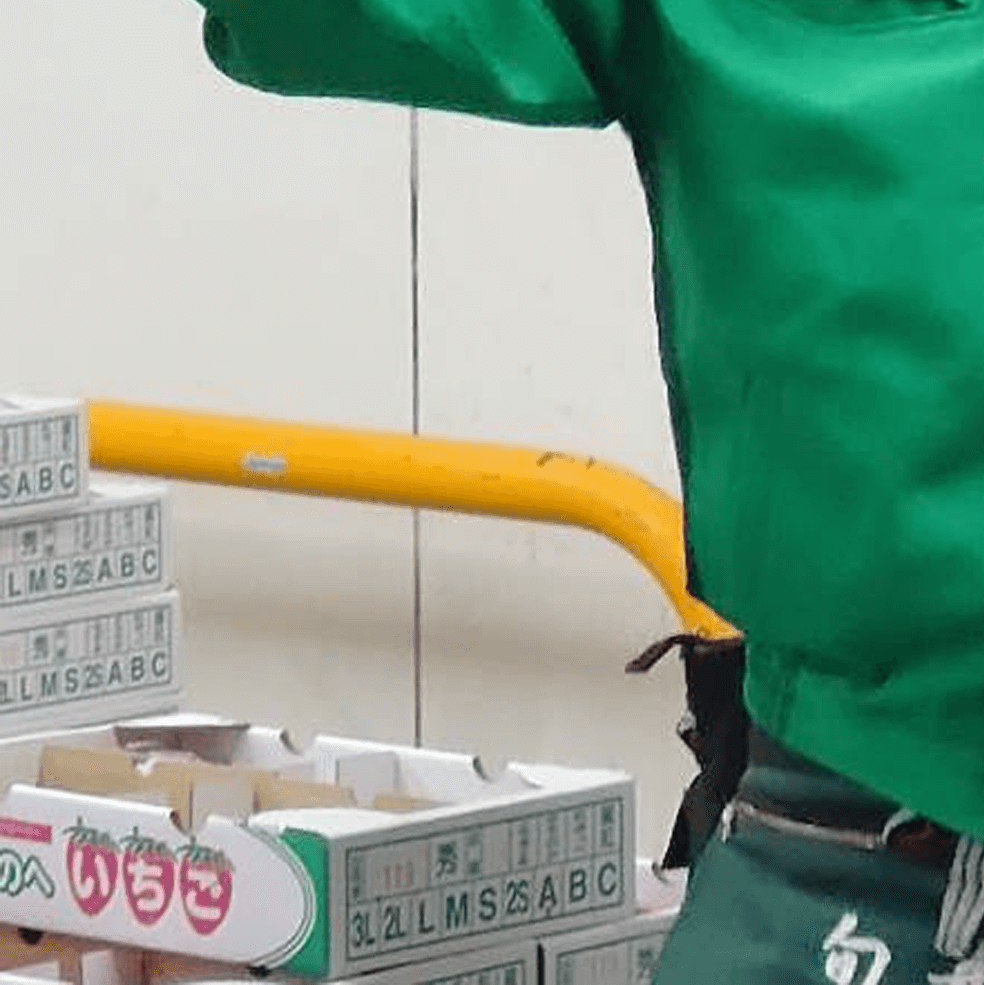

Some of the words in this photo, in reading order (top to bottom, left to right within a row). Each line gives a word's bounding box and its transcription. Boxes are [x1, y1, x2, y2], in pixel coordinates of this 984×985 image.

[17, 471, 31, 495] A
[39, 467, 53, 493] B
[60, 463, 74, 489] C
[53, 564, 67, 589] S
[98, 556, 112, 582] A
[120, 552, 135, 577] B
[142, 548, 157, 575] C
[20, 677, 33, 701] L
[41, 672, 57, 697] M
[65, 667, 79, 693] S
[108, 660, 122, 685] A
[131, 655, 145, 681] B
[151, 651, 166, 677] C
[71, 848, 223, 921] いちご
[353, 912, 376, 948] 3L
[385, 905, 406, 942] 2L
[418, 901, 435, 935] L
[446, 892, 468, 930] M
[478, 887, 497, 922] S
[506, 879, 529, 915] 2S
[538, 875, 557, 909] A
[569, 867, 588, 904] B
[597, 862, 618, 897] C
